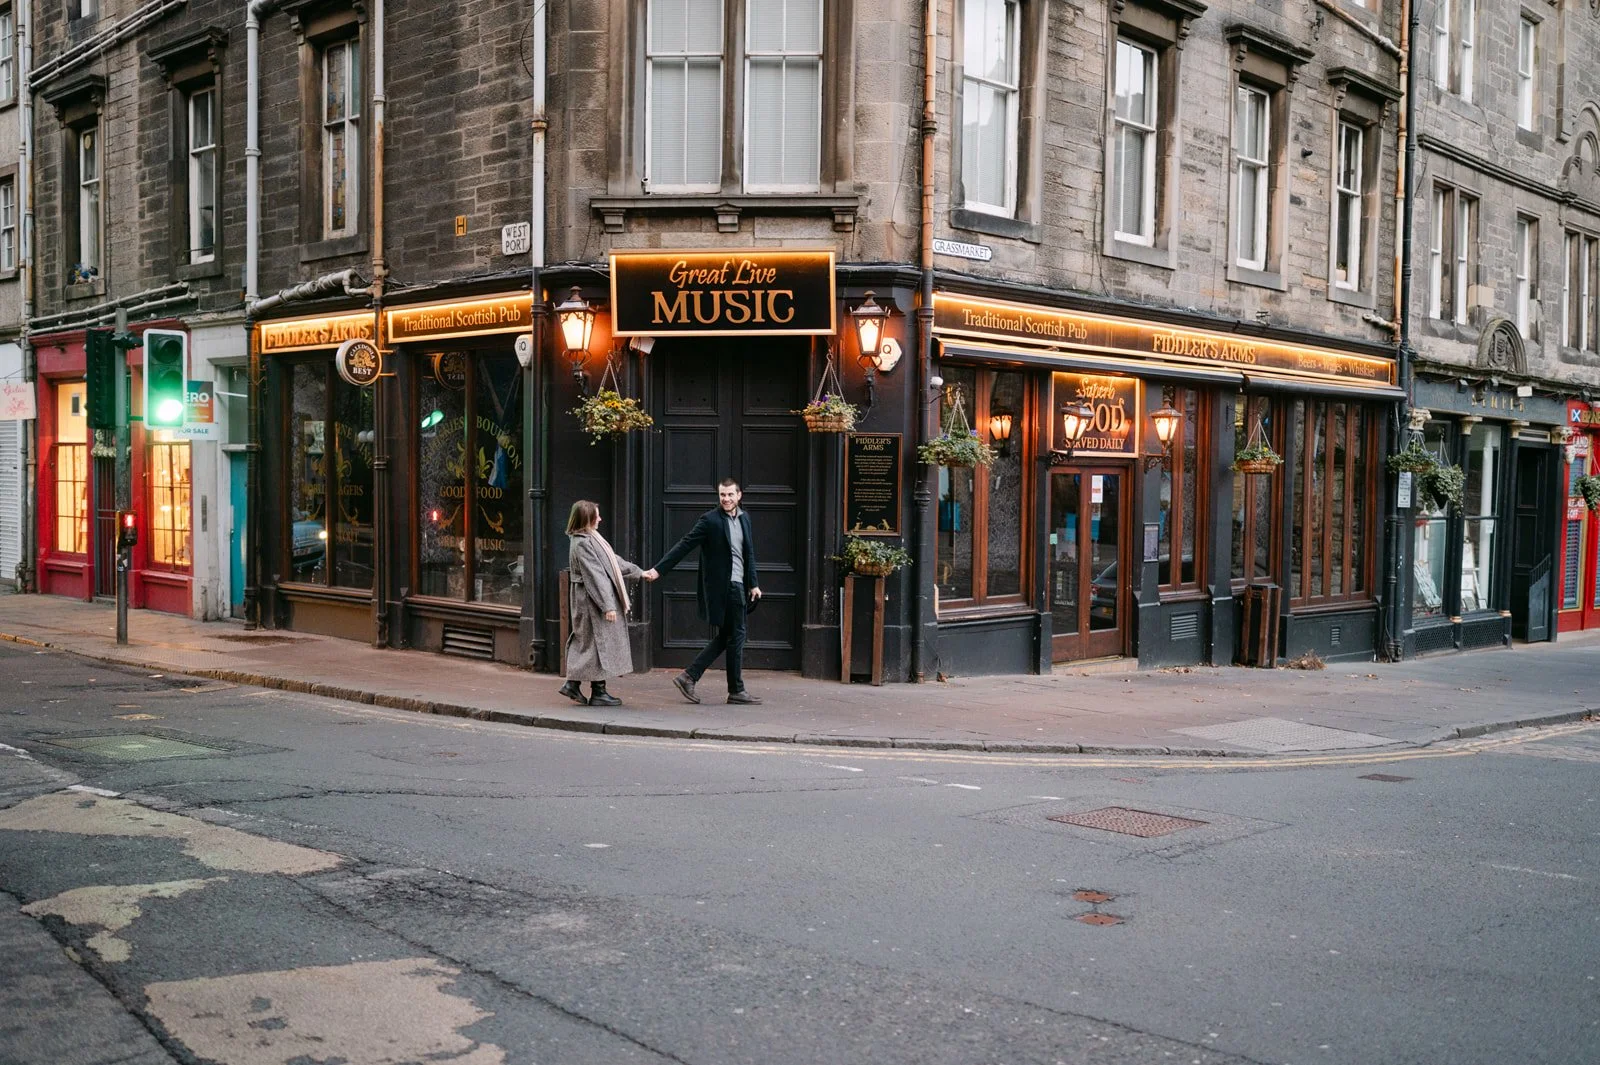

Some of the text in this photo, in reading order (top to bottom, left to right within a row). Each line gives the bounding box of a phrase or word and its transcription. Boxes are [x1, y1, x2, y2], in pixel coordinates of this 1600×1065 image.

[505, 225, 528, 239] WEST
[505, 239, 526, 252] PORT
[934, 241, 989, 259] GRASSMARKET
[669, 258, 777, 289] Great Live
[651, 290, 795, 324] MUSIC
[402, 304, 521, 332] Traditional Scottish Pub
[962, 308, 1087, 340] Traditional Scottish Pub
[266, 320, 370, 348] FIDDLER'S ARMS
[1152, 331, 1256, 364] FIDDLER'S ARMS
[353, 367, 372, 375] BEST
[1348, 361, 1376, 377] Whiskies
[1075, 377, 1116, 402] Superb
[855, 436, 892, 445] FIDDLER'S
[1065, 438, 1125, 450] SRVED DAILY
[338, 484, 364, 496] AGERS
[440, 485, 465, 498] GOOD
